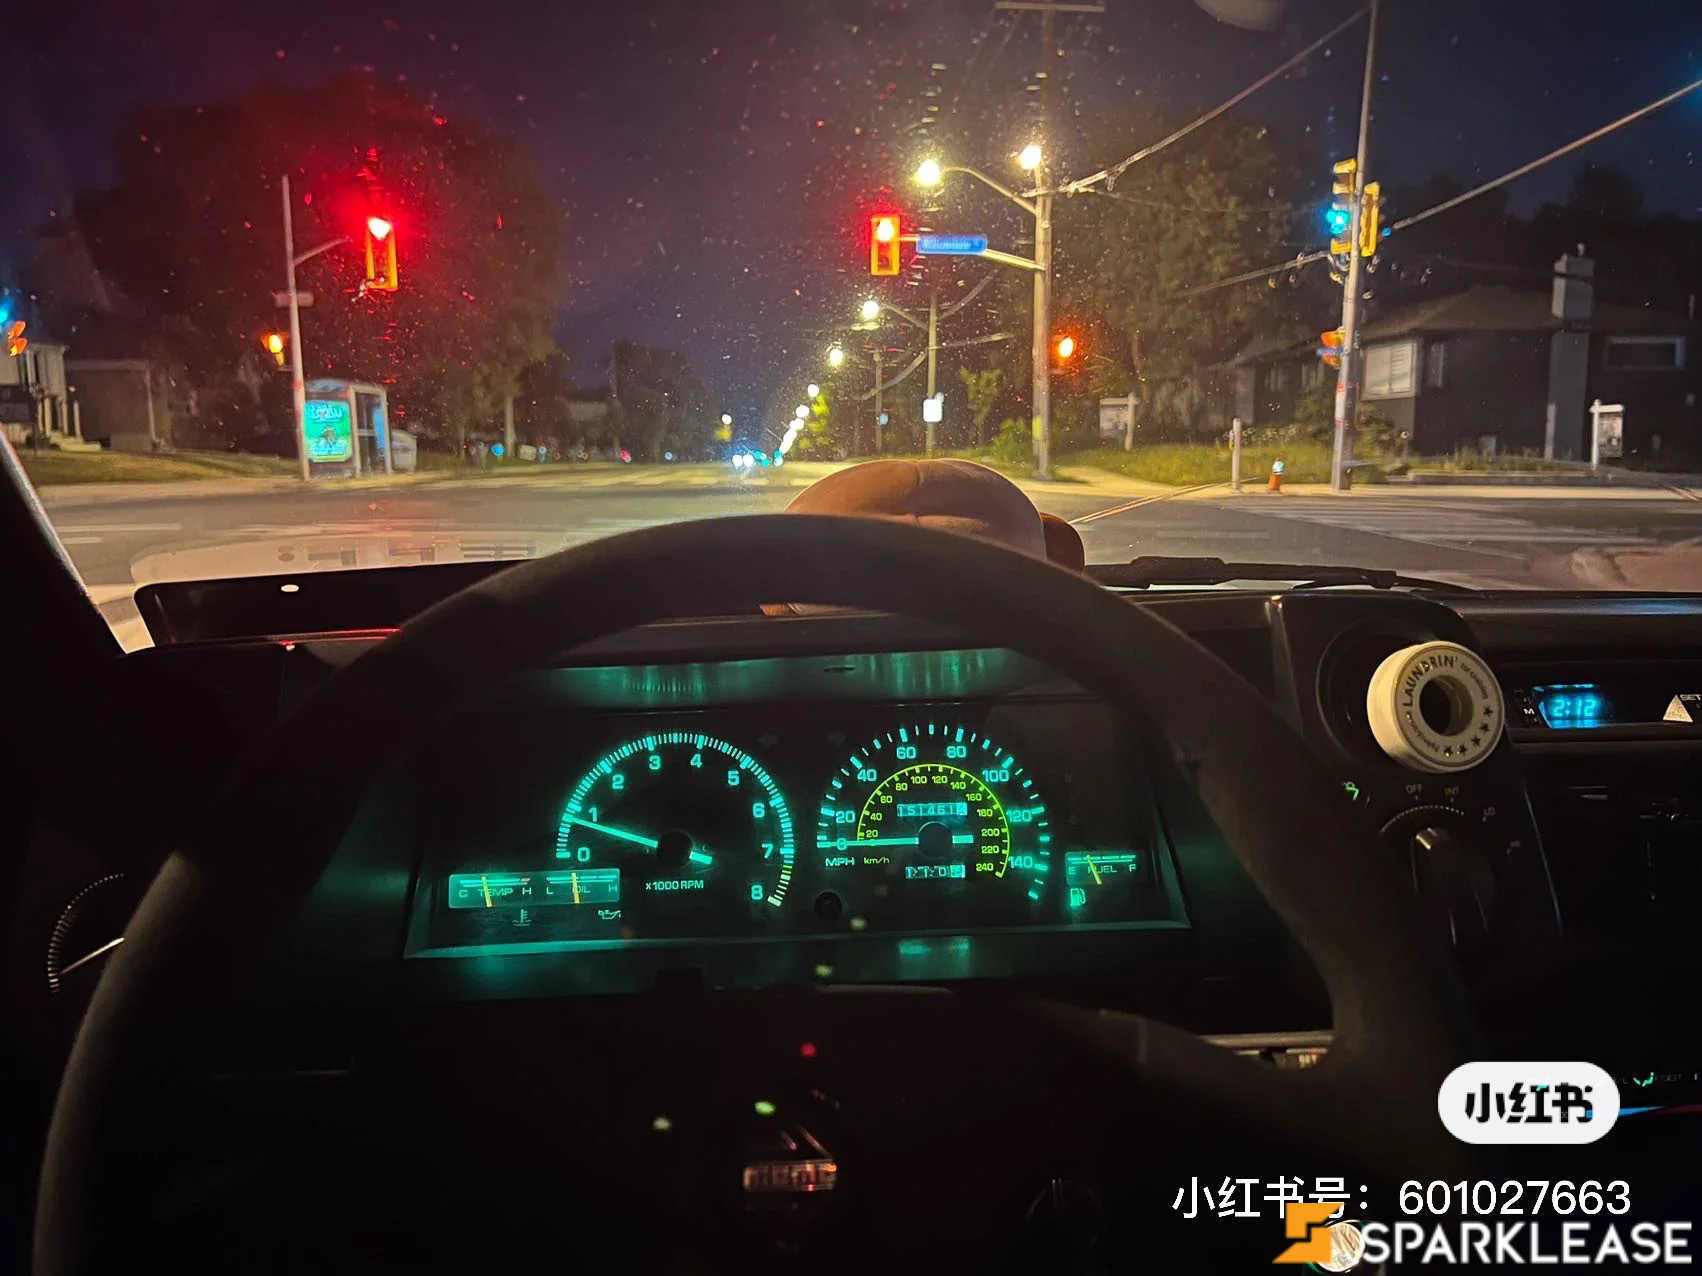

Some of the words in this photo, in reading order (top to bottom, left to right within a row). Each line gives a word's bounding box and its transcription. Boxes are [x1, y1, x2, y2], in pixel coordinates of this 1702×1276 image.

[1553, 699, 1597, 718] 2:12
[896, 746, 917, 760] 60
[946, 745, 967, 759] 80
[648, 755, 662, 770] 3
[690, 754, 703, 768] 4
[727, 771, 740, 786] 5
[856, 768, 877, 782] 40
[910, 775, 928, 785] 100
[931, 775, 948, 785] 120
[982, 769, 1010, 782] 100
[611, 775, 625, 790] 2
[895, 782, 908, 791] 80
[950, 781, 967, 790] 140
[880, 795, 893, 804] 60
[965, 792, 983, 802] 160
[588, 807, 598, 822] 1
[752, 803, 765, 818] 6
[976, 808, 993, 817] 180
[1007, 809, 1033, 822] 120
[835, 810, 856, 824] 20
[869, 812, 883, 822] 40
[865, 829, 879, 838] 20
[981, 828, 999, 837] 200
[577, 847, 591, 862] 0
[761, 844, 774, 859] 7
[981, 845, 999, 854] 220
[825, 856, 855, 868] MPH
[863, 855, 890, 865] km/h
[1009, 856, 1034, 869] 140
[975, 863, 994, 872] 240
[546, 886, 555, 896] L
[607, 884, 618, 893] H
[680, 879, 705, 890] RPM
[458, 889, 469, 898] C
[521, 887, 533, 896] H
[750, 885, 764, 900] 8
